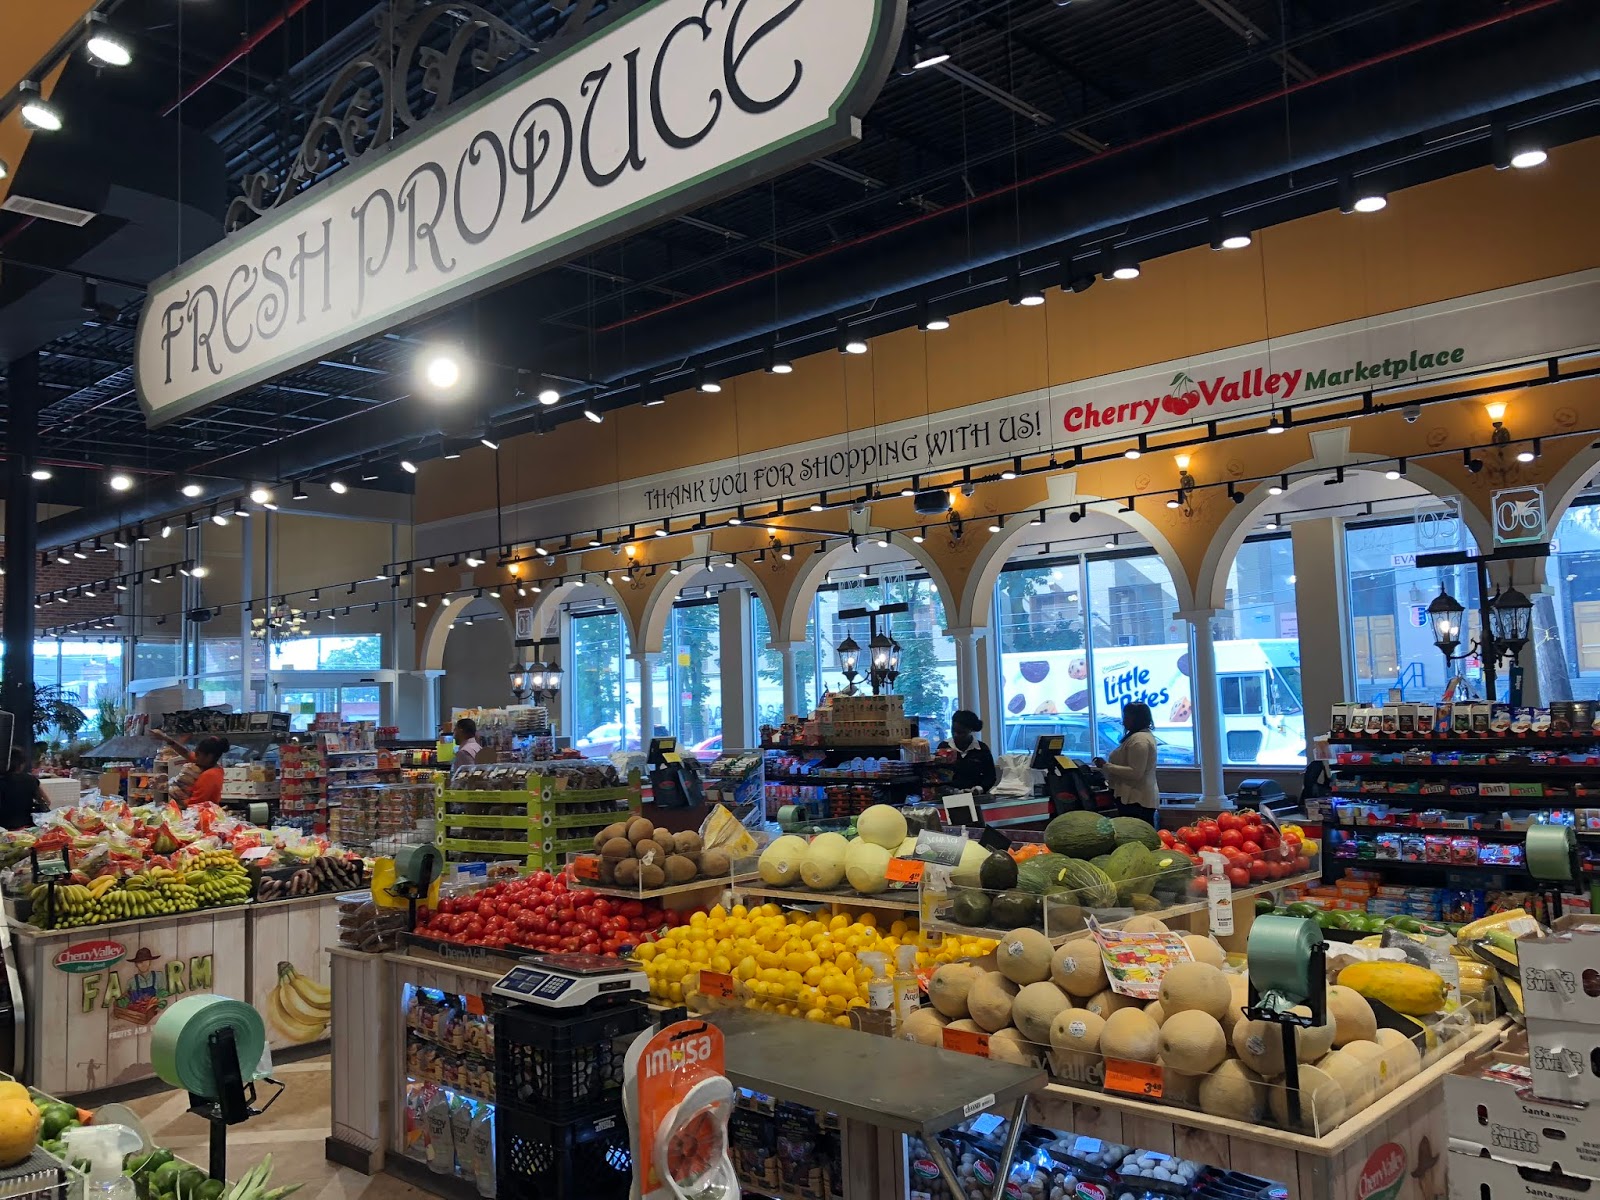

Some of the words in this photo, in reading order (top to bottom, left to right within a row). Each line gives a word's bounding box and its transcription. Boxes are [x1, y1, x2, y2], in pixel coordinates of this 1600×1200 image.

[161, 218, 334, 384] FRESH
[351, 0, 803, 320] PRODUCE
[1063, 395, 1160, 433] Cherry
[1198, 367, 1302, 406] Valley
[1305, 347, 1465, 391] Marketplace
[644, 485, 706, 511] THANK
[709, 472, 748, 502] YOU
[754, 463, 796, 490] FOR
[800, 434, 919, 481] SHOPPING
[926, 421, 991, 458] WITH
[998, 411, 1042, 443] US!
[1497, 498, 1541, 532] 06
[1104, 666, 1151, 705] Little
[1525, 967, 1575, 983] Saa
[1522, 1105, 1551, 1117] Santa
[1490, 1123, 1538, 1143] Santa
[1491, 1134, 1540, 1154] SWEETS
